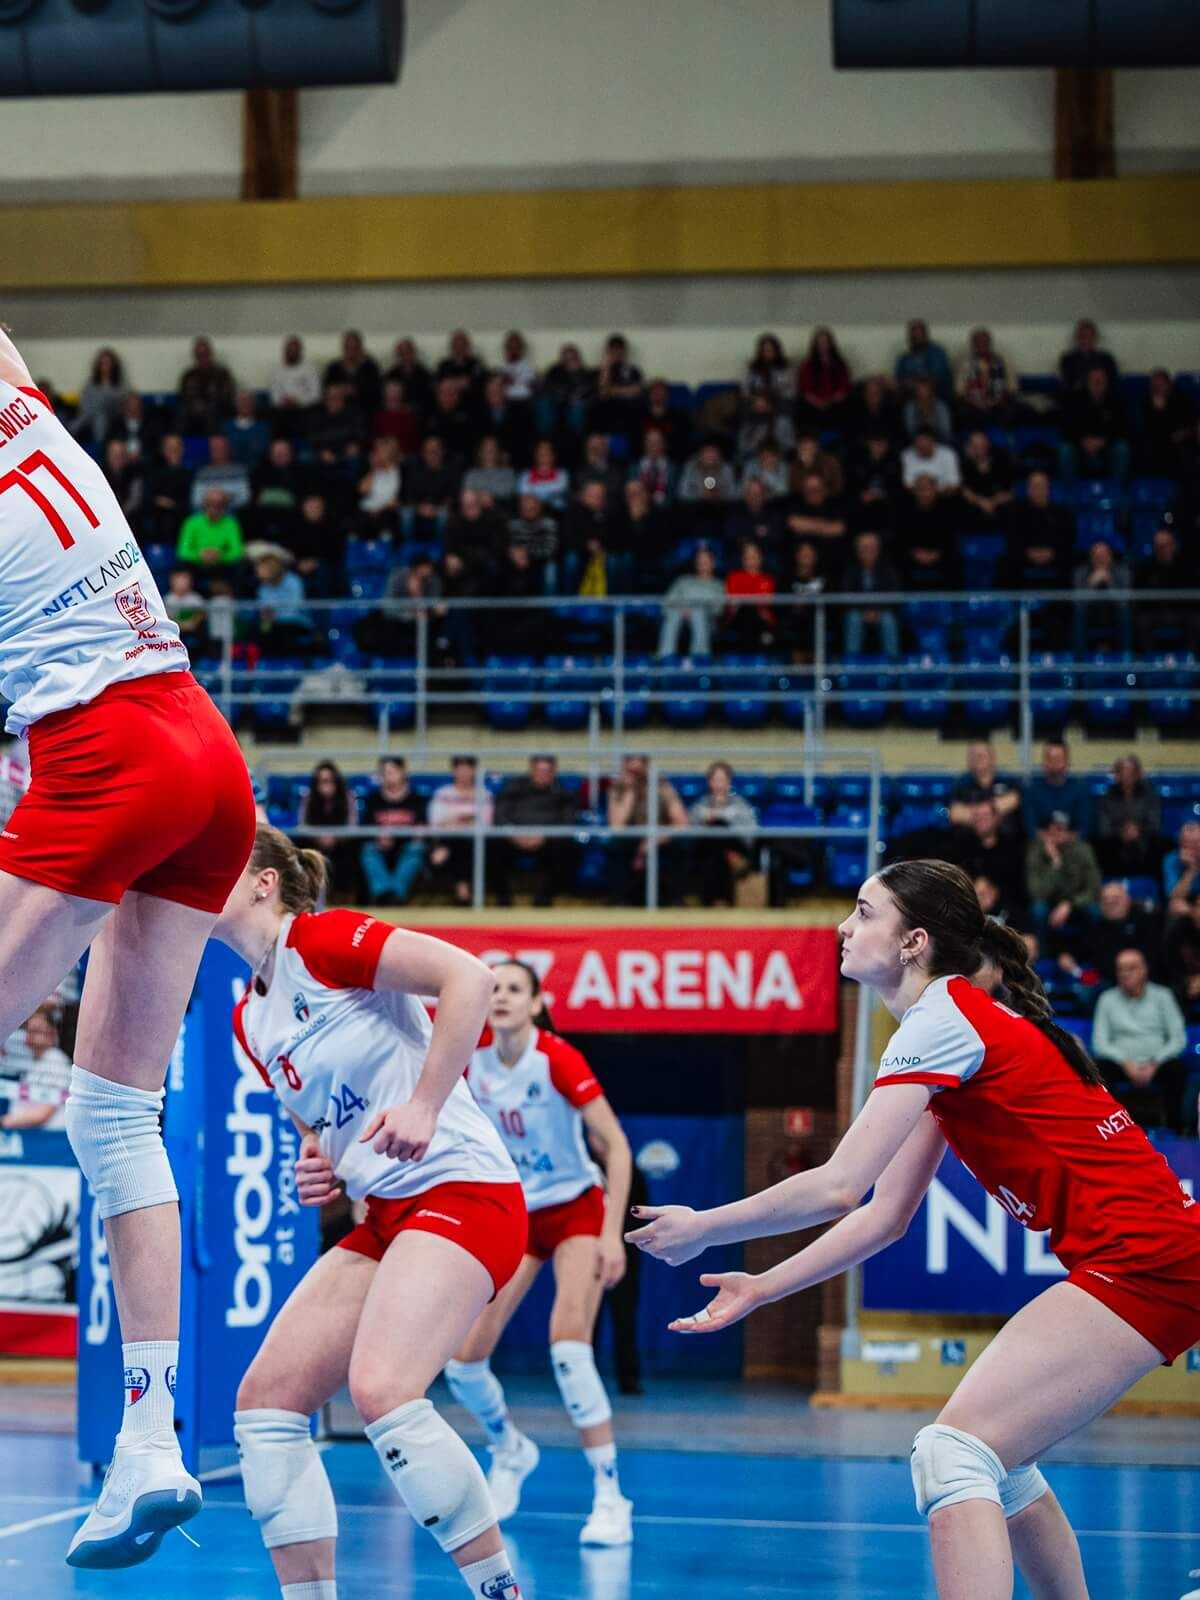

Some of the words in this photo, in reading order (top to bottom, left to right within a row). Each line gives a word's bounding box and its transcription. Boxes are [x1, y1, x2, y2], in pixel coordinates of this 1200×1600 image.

[567, 950, 804, 1010] ARENA
[226, 977, 274, 1327] broth
[499, 1110, 526, 1138] 10
